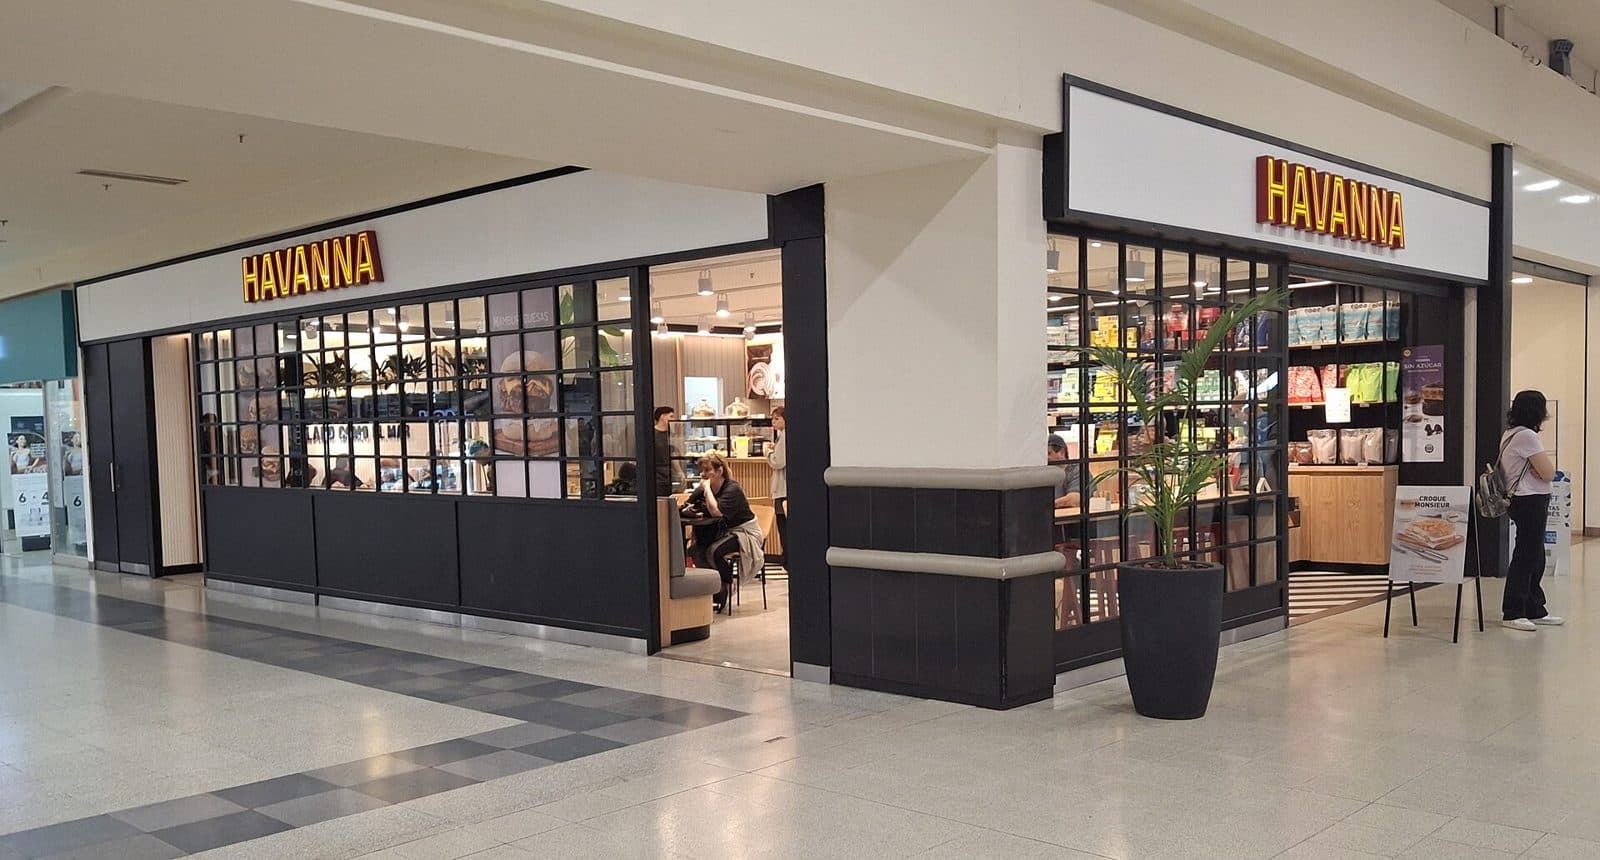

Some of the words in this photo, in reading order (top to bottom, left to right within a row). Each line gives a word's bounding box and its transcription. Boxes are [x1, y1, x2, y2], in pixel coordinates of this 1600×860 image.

[1259, 155, 1405, 250] HAVANNA
[242, 231, 381, 303] HAVANNA
[1416, 361, 1442, 369] AZÚCAR
